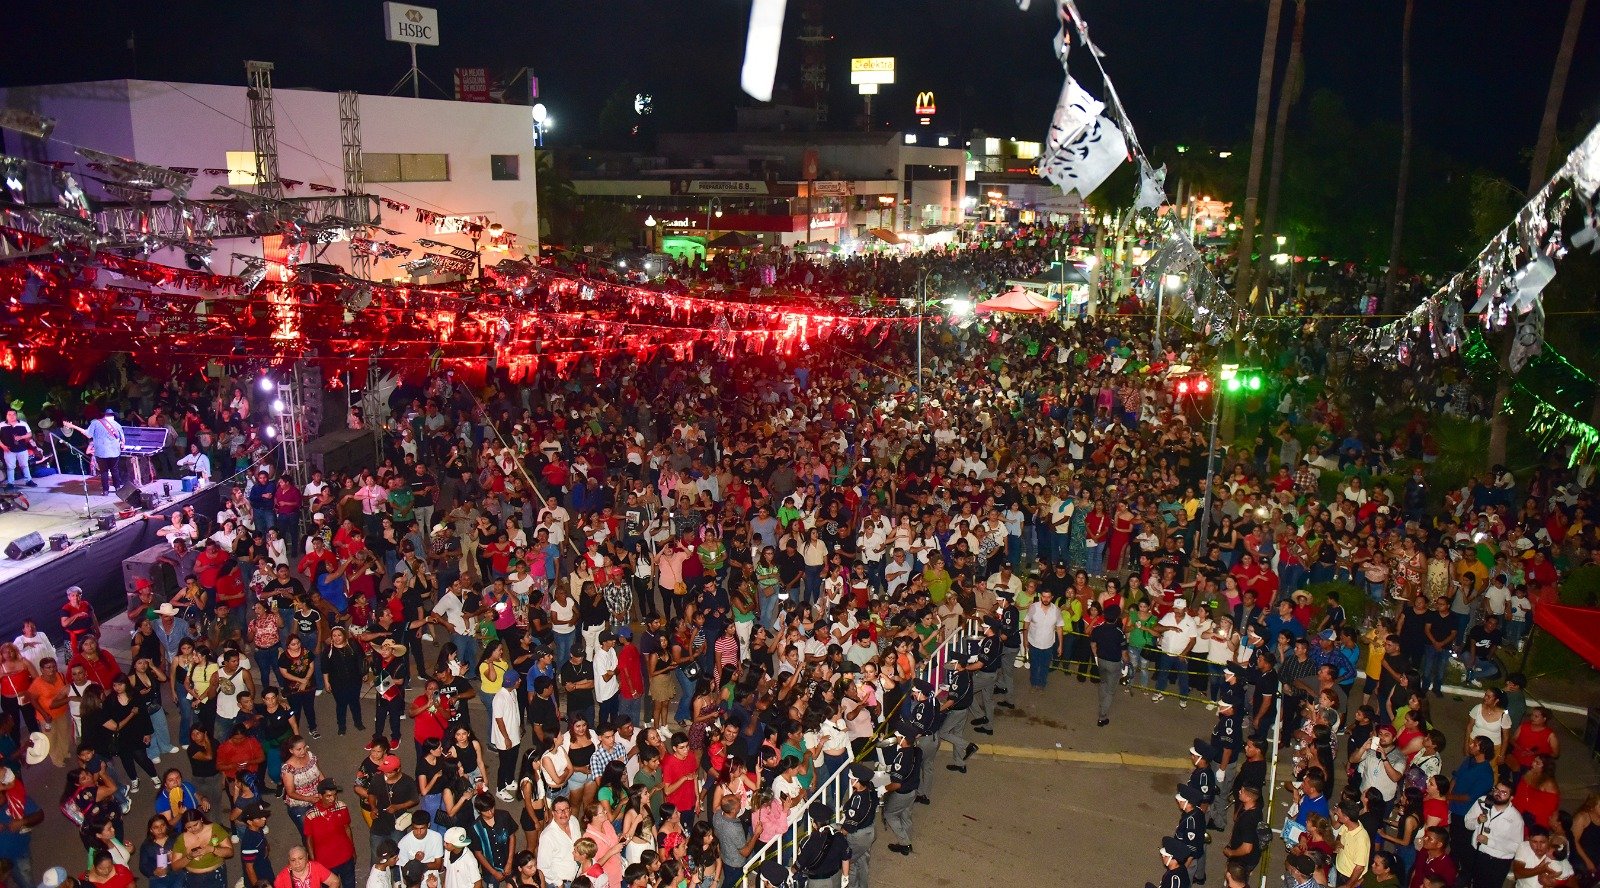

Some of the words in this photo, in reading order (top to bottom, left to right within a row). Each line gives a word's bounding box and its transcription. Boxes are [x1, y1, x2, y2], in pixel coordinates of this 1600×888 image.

[399, 22, 432, 39] HSBC
[469, 68, 485, 77] MEJOR
[462, 76, 486, 84] GASOLINA
